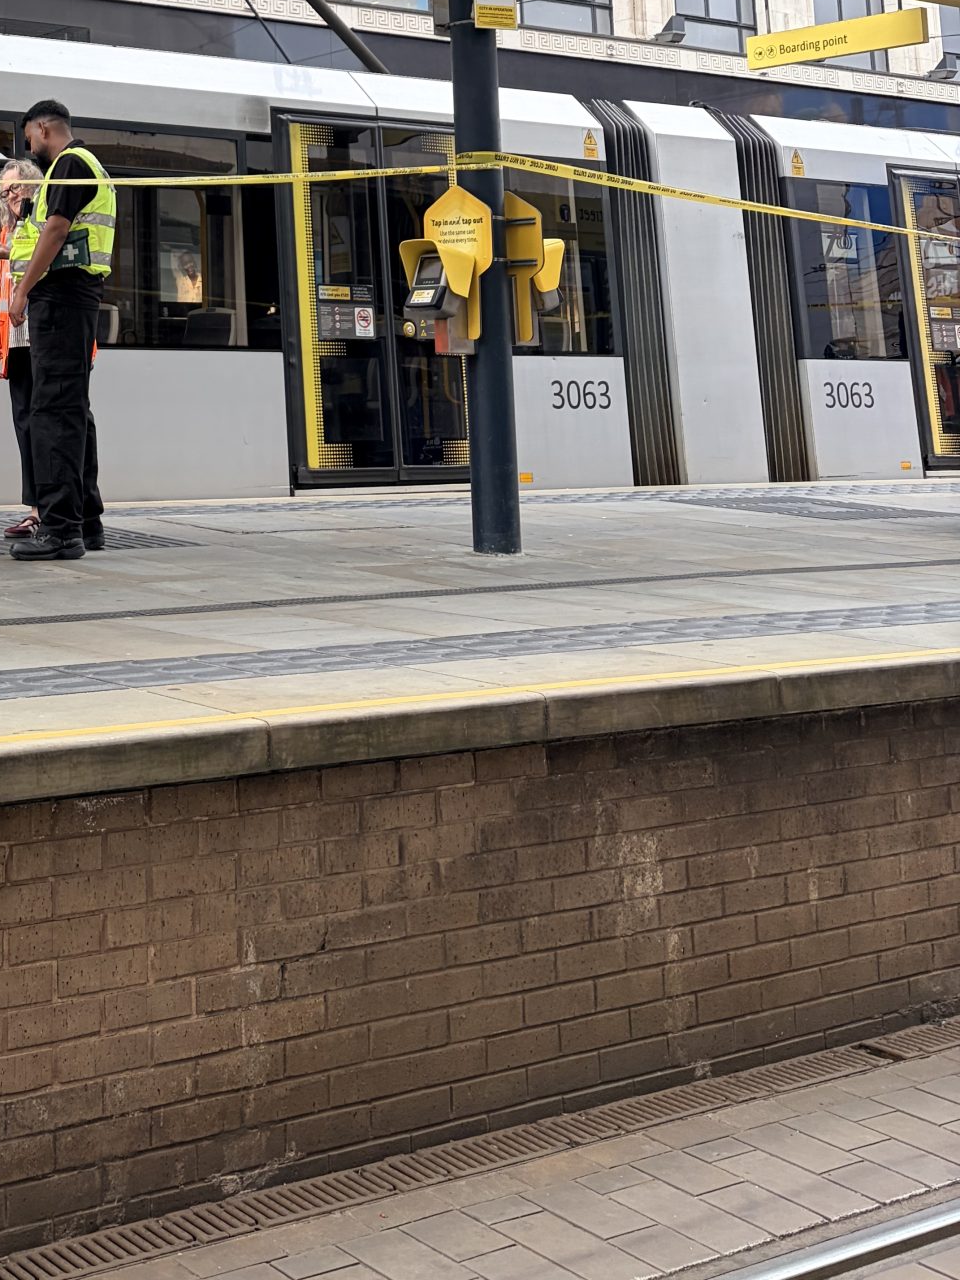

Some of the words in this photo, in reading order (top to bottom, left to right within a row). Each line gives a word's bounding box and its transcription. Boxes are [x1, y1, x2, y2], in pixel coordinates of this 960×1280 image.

[779, 39, 821, 55] Boarding
[822, 35, 849, 50] point
[431, 219, 442, 229] Tap
[461, 218, 472, 226] tap
[551, 379, 612, 410] 3063
[823, 381, 875, 409] 3063
